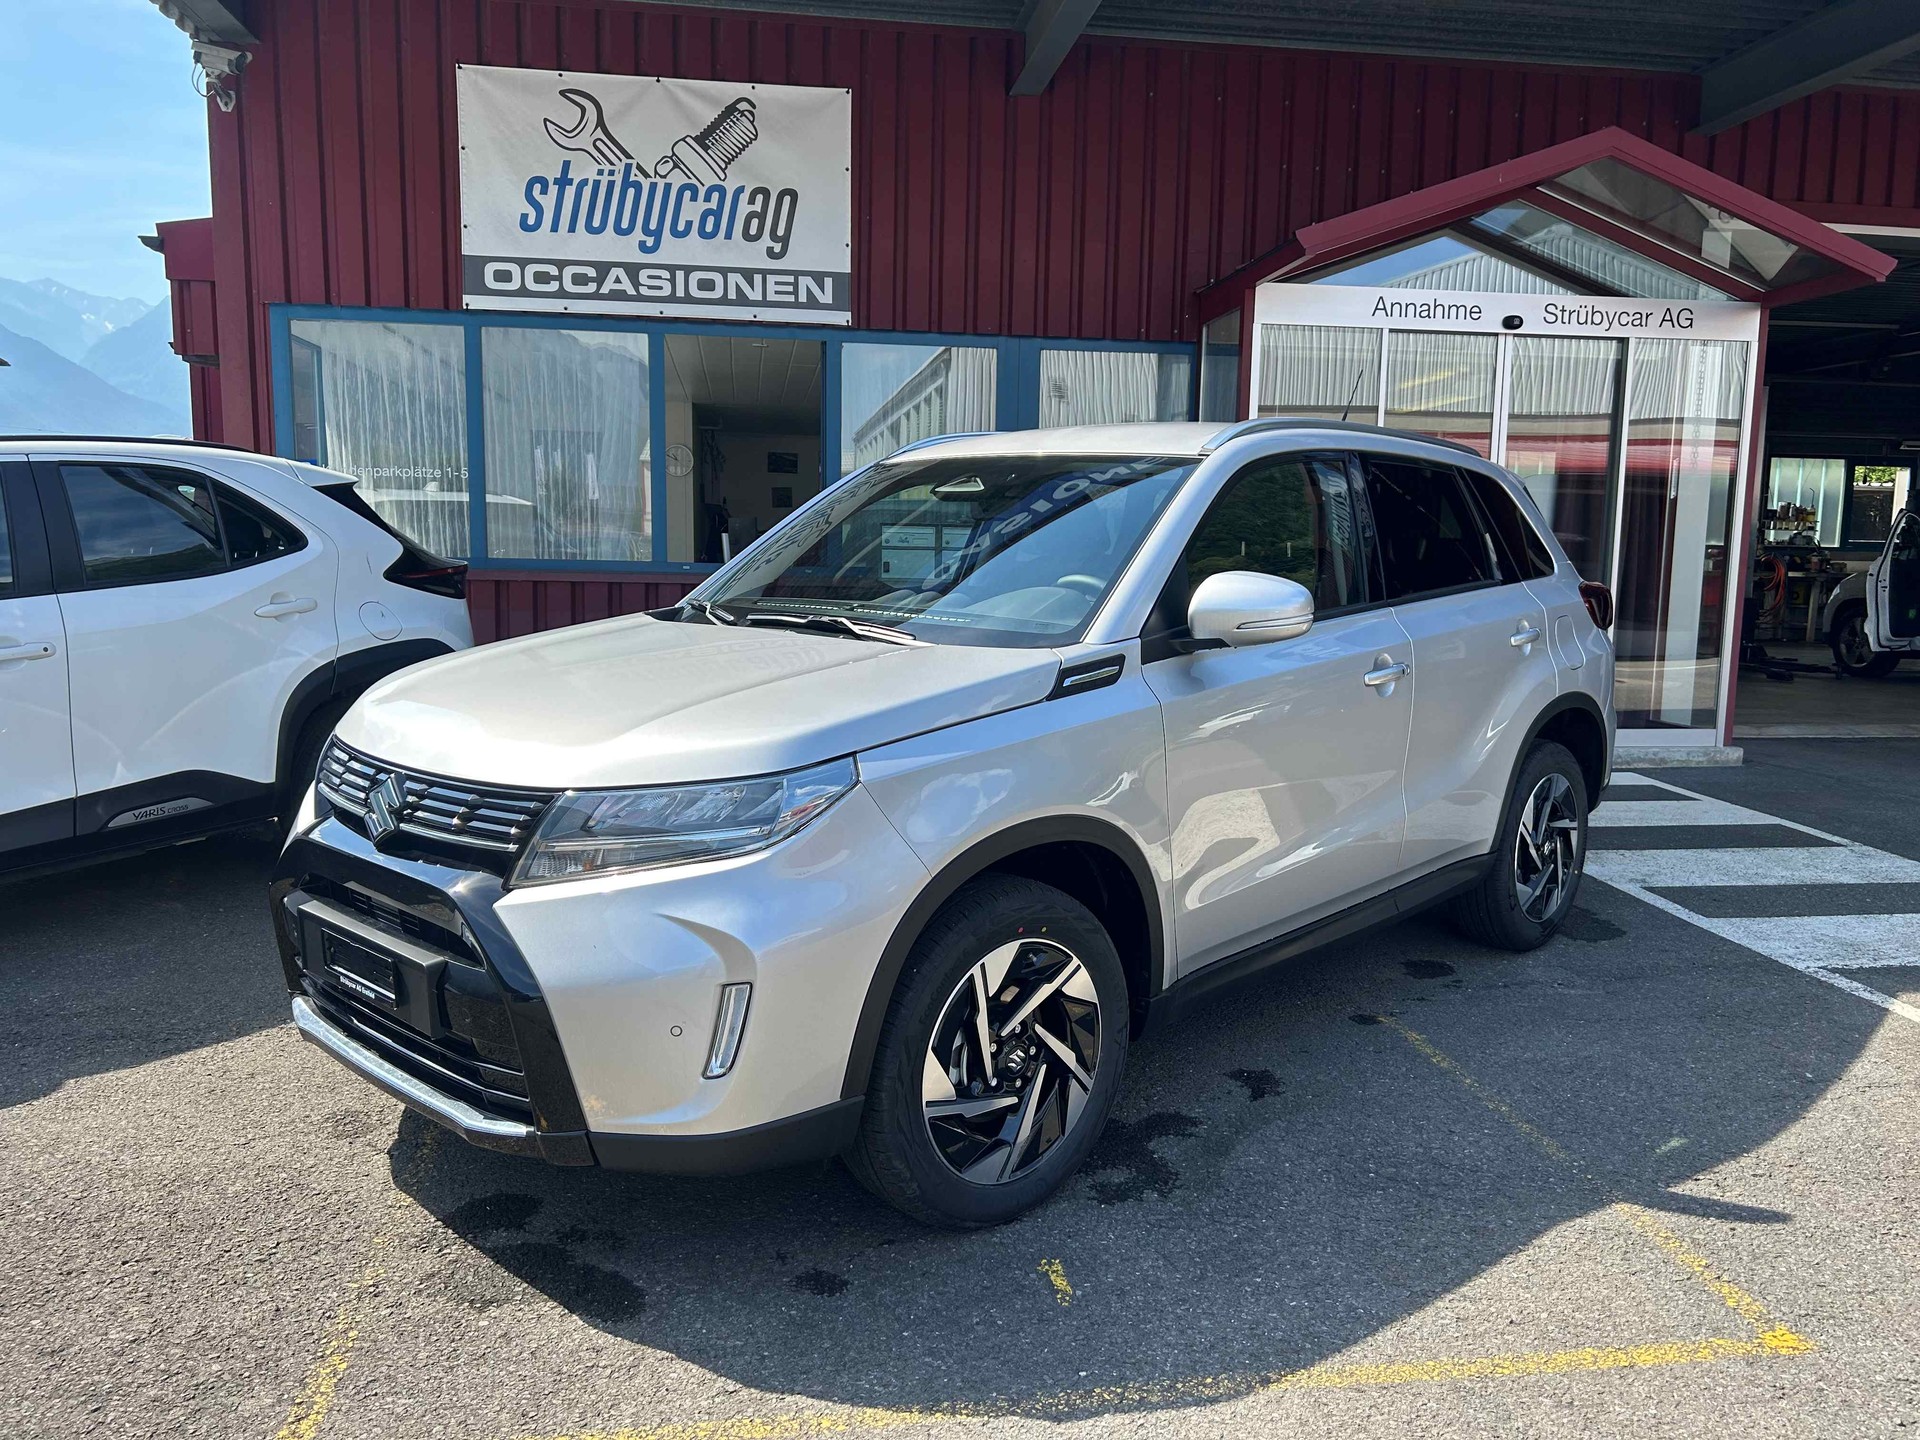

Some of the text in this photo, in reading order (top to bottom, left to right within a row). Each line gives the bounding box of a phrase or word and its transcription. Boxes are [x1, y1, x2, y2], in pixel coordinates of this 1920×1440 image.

[483, 261, 833, 304] OCCASIONEN
[1372, 296, 1482, 321] Annahme
[1543, 303, 1694, 332] Strübycar AG
[322, 464, 442, 480] denparkplätze
[167, 804, 189, 814] CROSS
